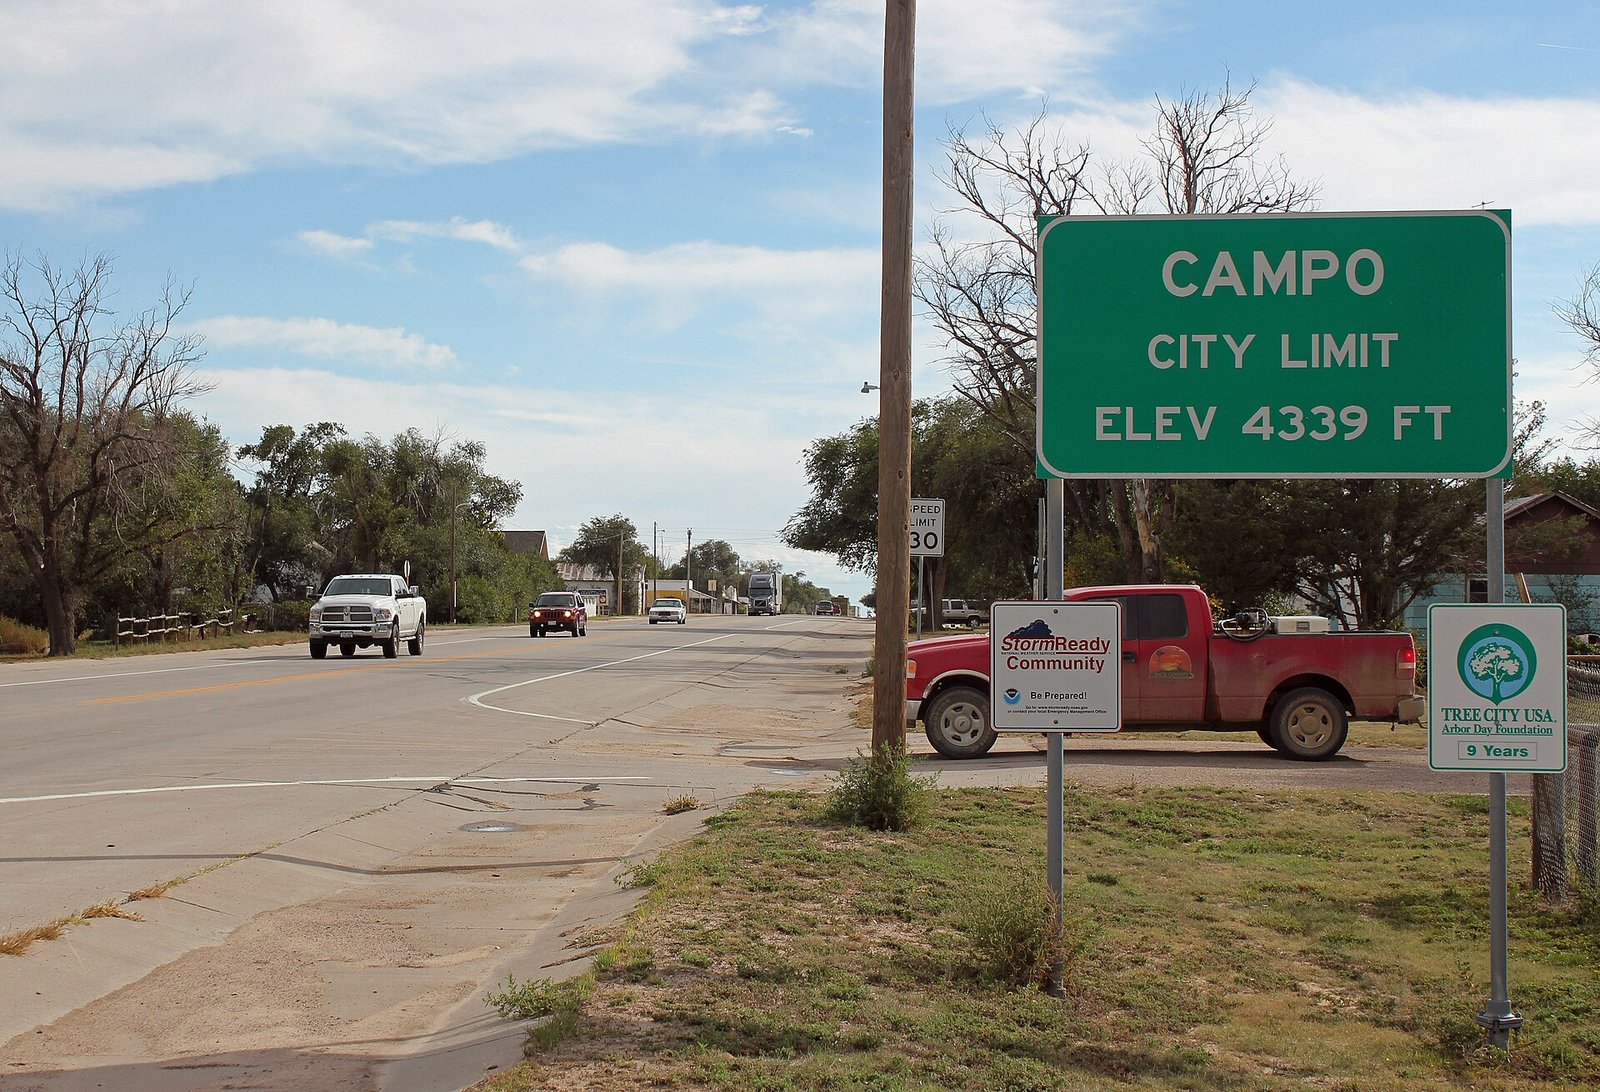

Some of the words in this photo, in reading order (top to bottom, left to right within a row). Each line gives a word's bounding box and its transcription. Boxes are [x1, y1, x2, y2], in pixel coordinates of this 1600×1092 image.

[1162, 248, 1385, 297] CAMPO
[1148, 334, 1256, 369] CITY
[1281, 333, 1399, 368] LIMIT
[1095, 406, 1217, 441] ELEV
[1242, 405, 1368, 441] 4339
[1393, 405, 1451, 440] FT
[910, 505, 941, 514] PEED
[909, 531, 938, 550] 30
[1001, 636, 1111, 654] StormReady
[1006, 655, 1105, 674] Community
[1030, 691, 1042, 700] Be
[1044, 691, 1087, 701] Prepared!
[1441, 707, 1481, 722] TREE
[1483, 708, 1520, 722] CITY
[1441, 723, 1471, 734] Arbor
[1474, 723, 1492, 736] Day
[1495, 724, 1553, 735] Foundation
[1466, 744, 1477, 757] 9
[1483, 744, 1529, 757] Years
